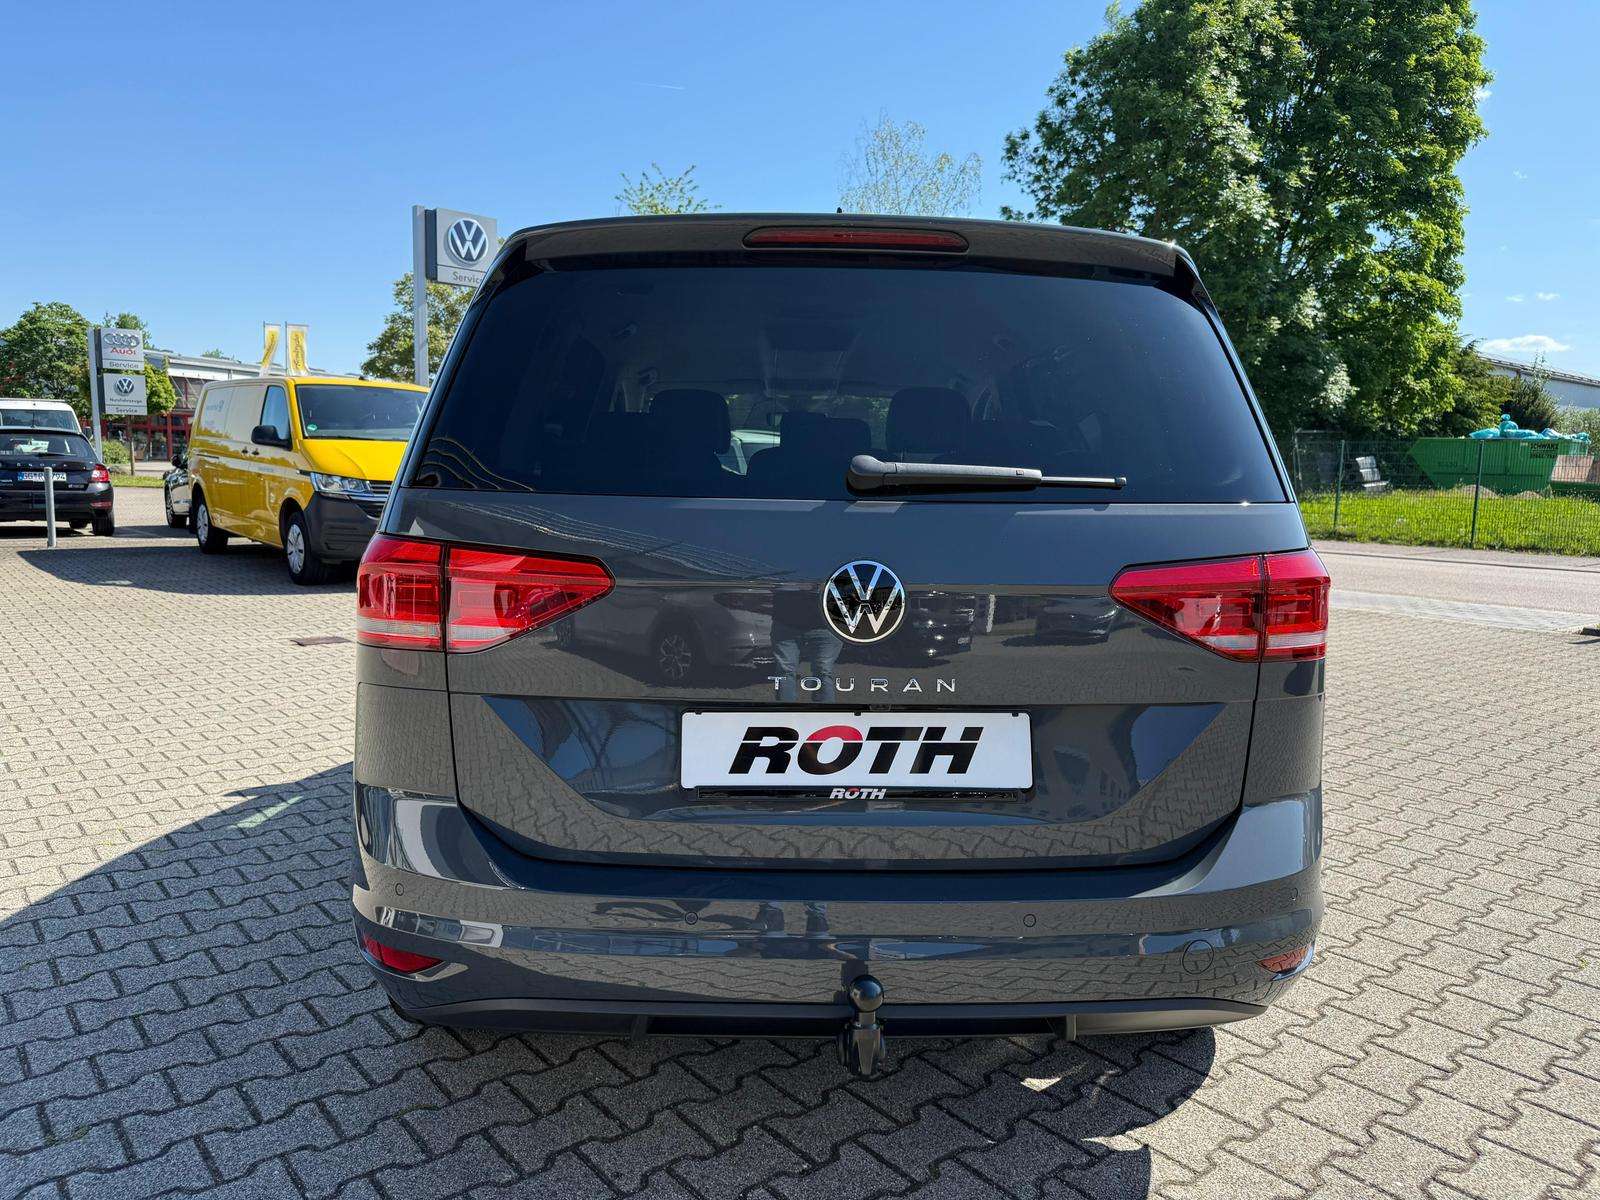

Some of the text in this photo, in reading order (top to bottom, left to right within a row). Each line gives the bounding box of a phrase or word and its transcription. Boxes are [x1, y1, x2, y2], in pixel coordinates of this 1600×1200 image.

[452, 271, 482, 284] Servic
[110, 347, 137, 356] Audi
[109, 361, 139, 369] Service
[767, 675, 957, 693] TOURAN
[728, 725, 985, 776] ROTH
[829, 787, 887, 800] ROTH
